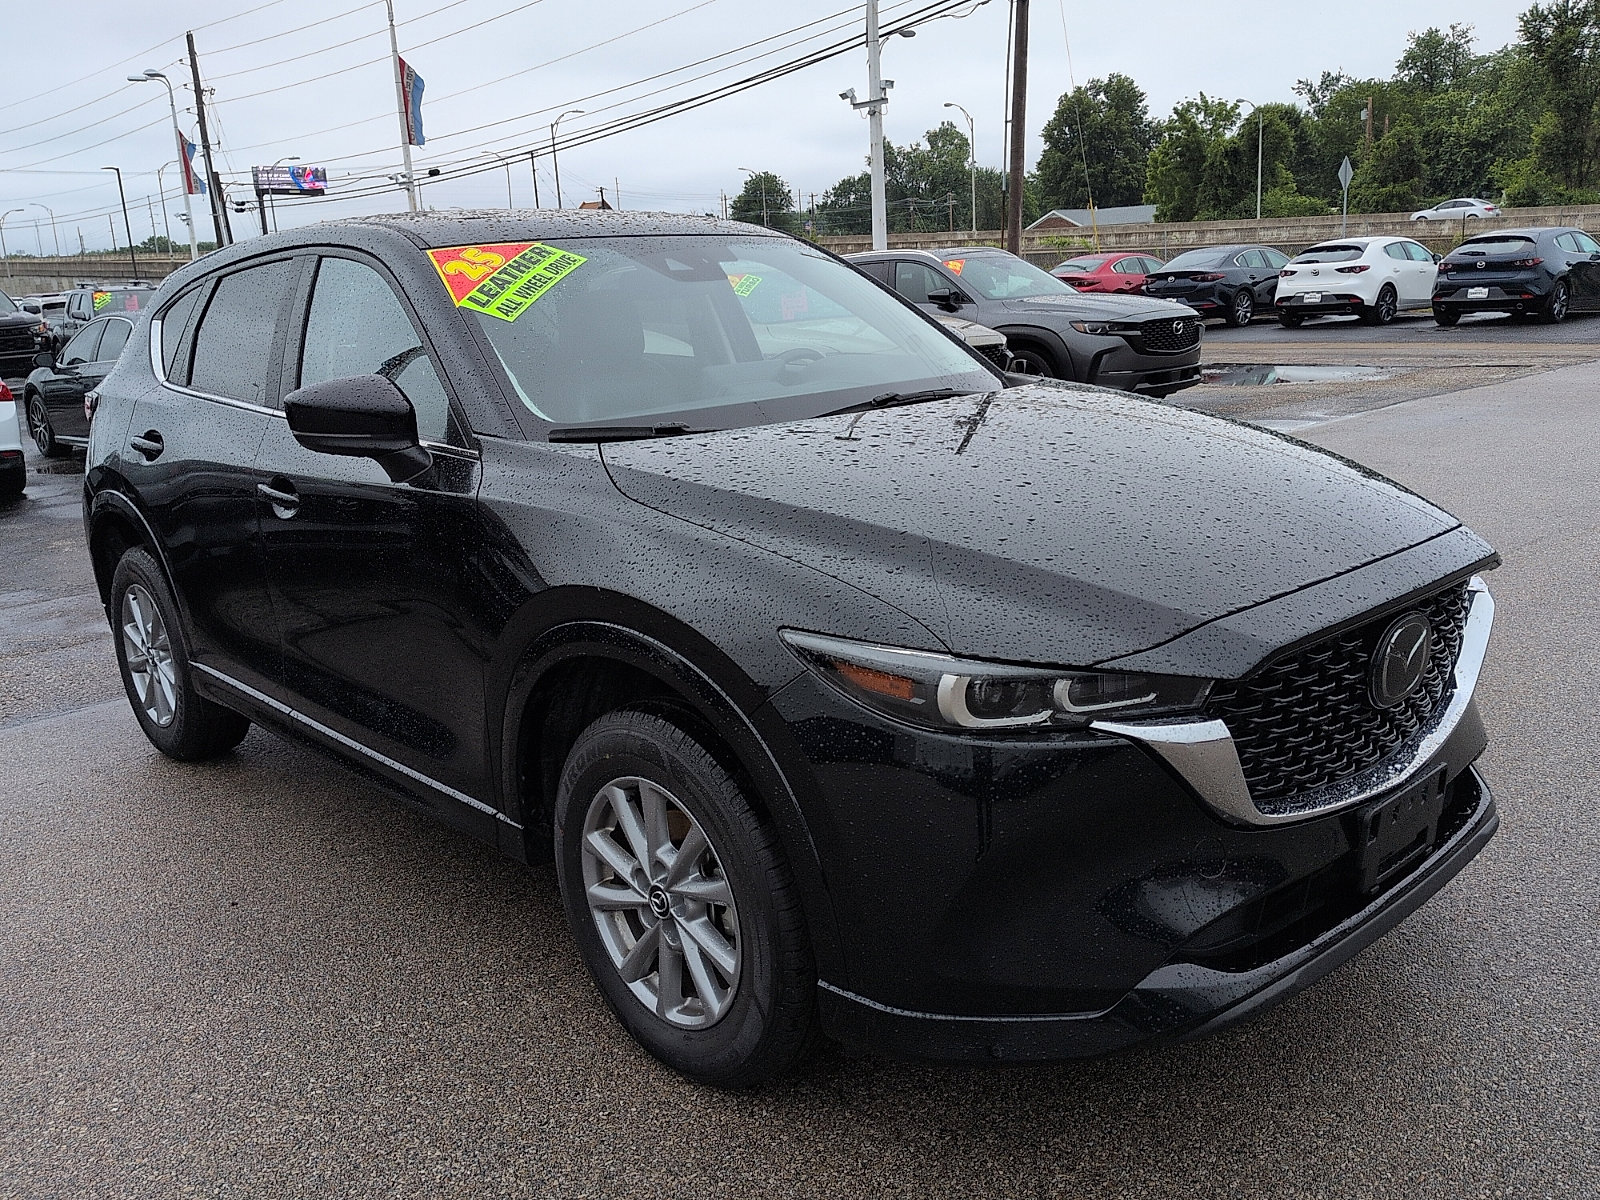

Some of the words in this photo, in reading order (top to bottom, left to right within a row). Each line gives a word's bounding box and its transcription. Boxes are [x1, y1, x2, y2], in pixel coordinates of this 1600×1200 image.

[443, 248, 506, 281] 25
[467, 245, 556, 308] LEATHER
[495, 298, 525, 318] ALL
[512, 272, 554, 299] WHEEL
[544, 254, 580, 276] DRIVE
